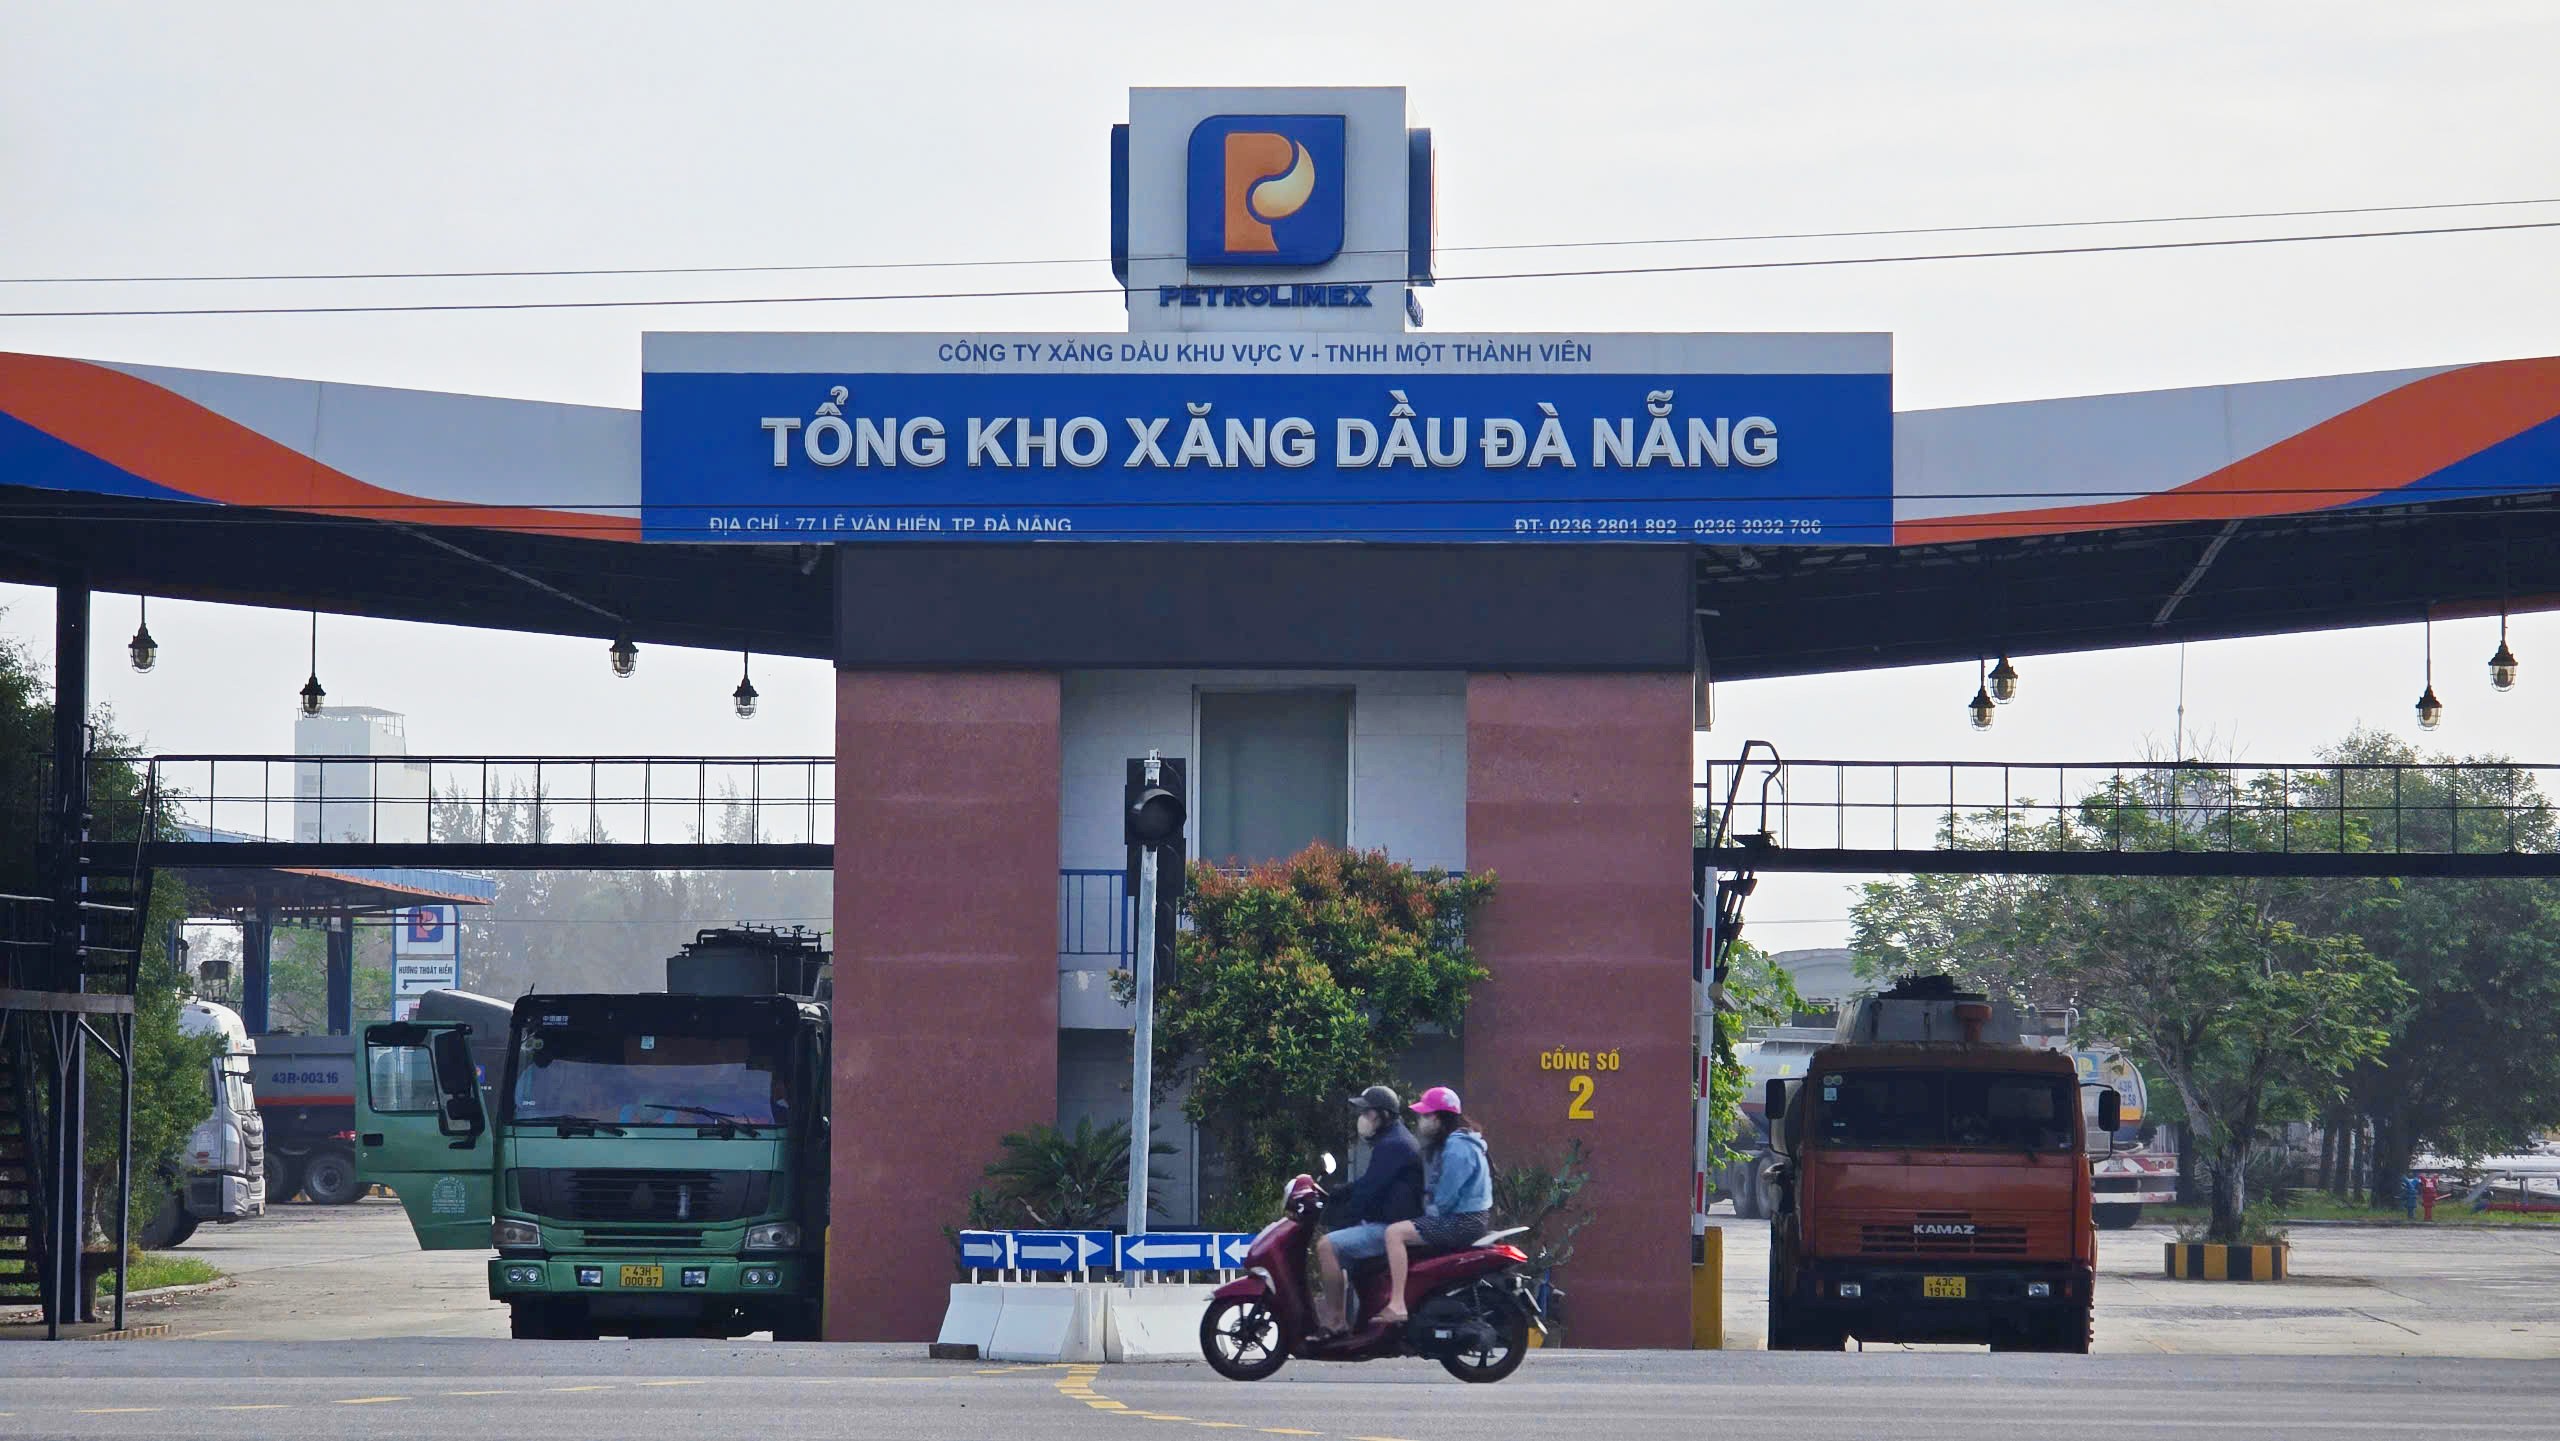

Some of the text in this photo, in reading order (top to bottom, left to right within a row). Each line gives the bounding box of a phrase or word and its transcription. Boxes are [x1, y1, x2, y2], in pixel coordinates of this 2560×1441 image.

[1159, 284, 1373, 307] PETROLIMEX
[938, 340, 1006, 362] CÔNG
[1013, 344, 1042, 362] TY
[1047, 340, 1113, 362] XĂNG
[1121, 339, 1168, 362] DẦU
[1177, 344, 1225, 362] KHU
[1232, 344, 1281, 366] VỰC
[1291, 344, 1304, 362] V
[1325, 344, 1387, 362] TNHH
[1396, 341, 1446, 366] MỘT
[1452, 340, 1532, 362] THÀNH
[1539, 340, 1592, 362] VIÊN
[761, 385, 1779, 468] TỔNG KHO XĂNG DẦU ĐÀ NẴNG
[709, 517, 741, 536] ĐỊA
[747, 514, 779, 532] CHỈ
[795, 518, 816, 531] 77
[851, 514, 890, 531] VĂN
[984, 514, 1011, 531] ĐÀ
[1515, 519, 1543, 534] ĐT:
[1550, 519, 1592, 533] 0236
[1597, 519, 1638, 533] 2801
[1645, 519, 1677, 533] 892
[1694, 519, 1736, 534] 0236
[1541, 1044, 1620, 1070] CỔNG SỐ
[1569, 1075, 1594, 1119] 2
[1913, 1224, 1975, 1234] KAMAZ
[633, 1266, 651, 1276] 43H
[1929, 1287, 1962, 1297] 191.43
